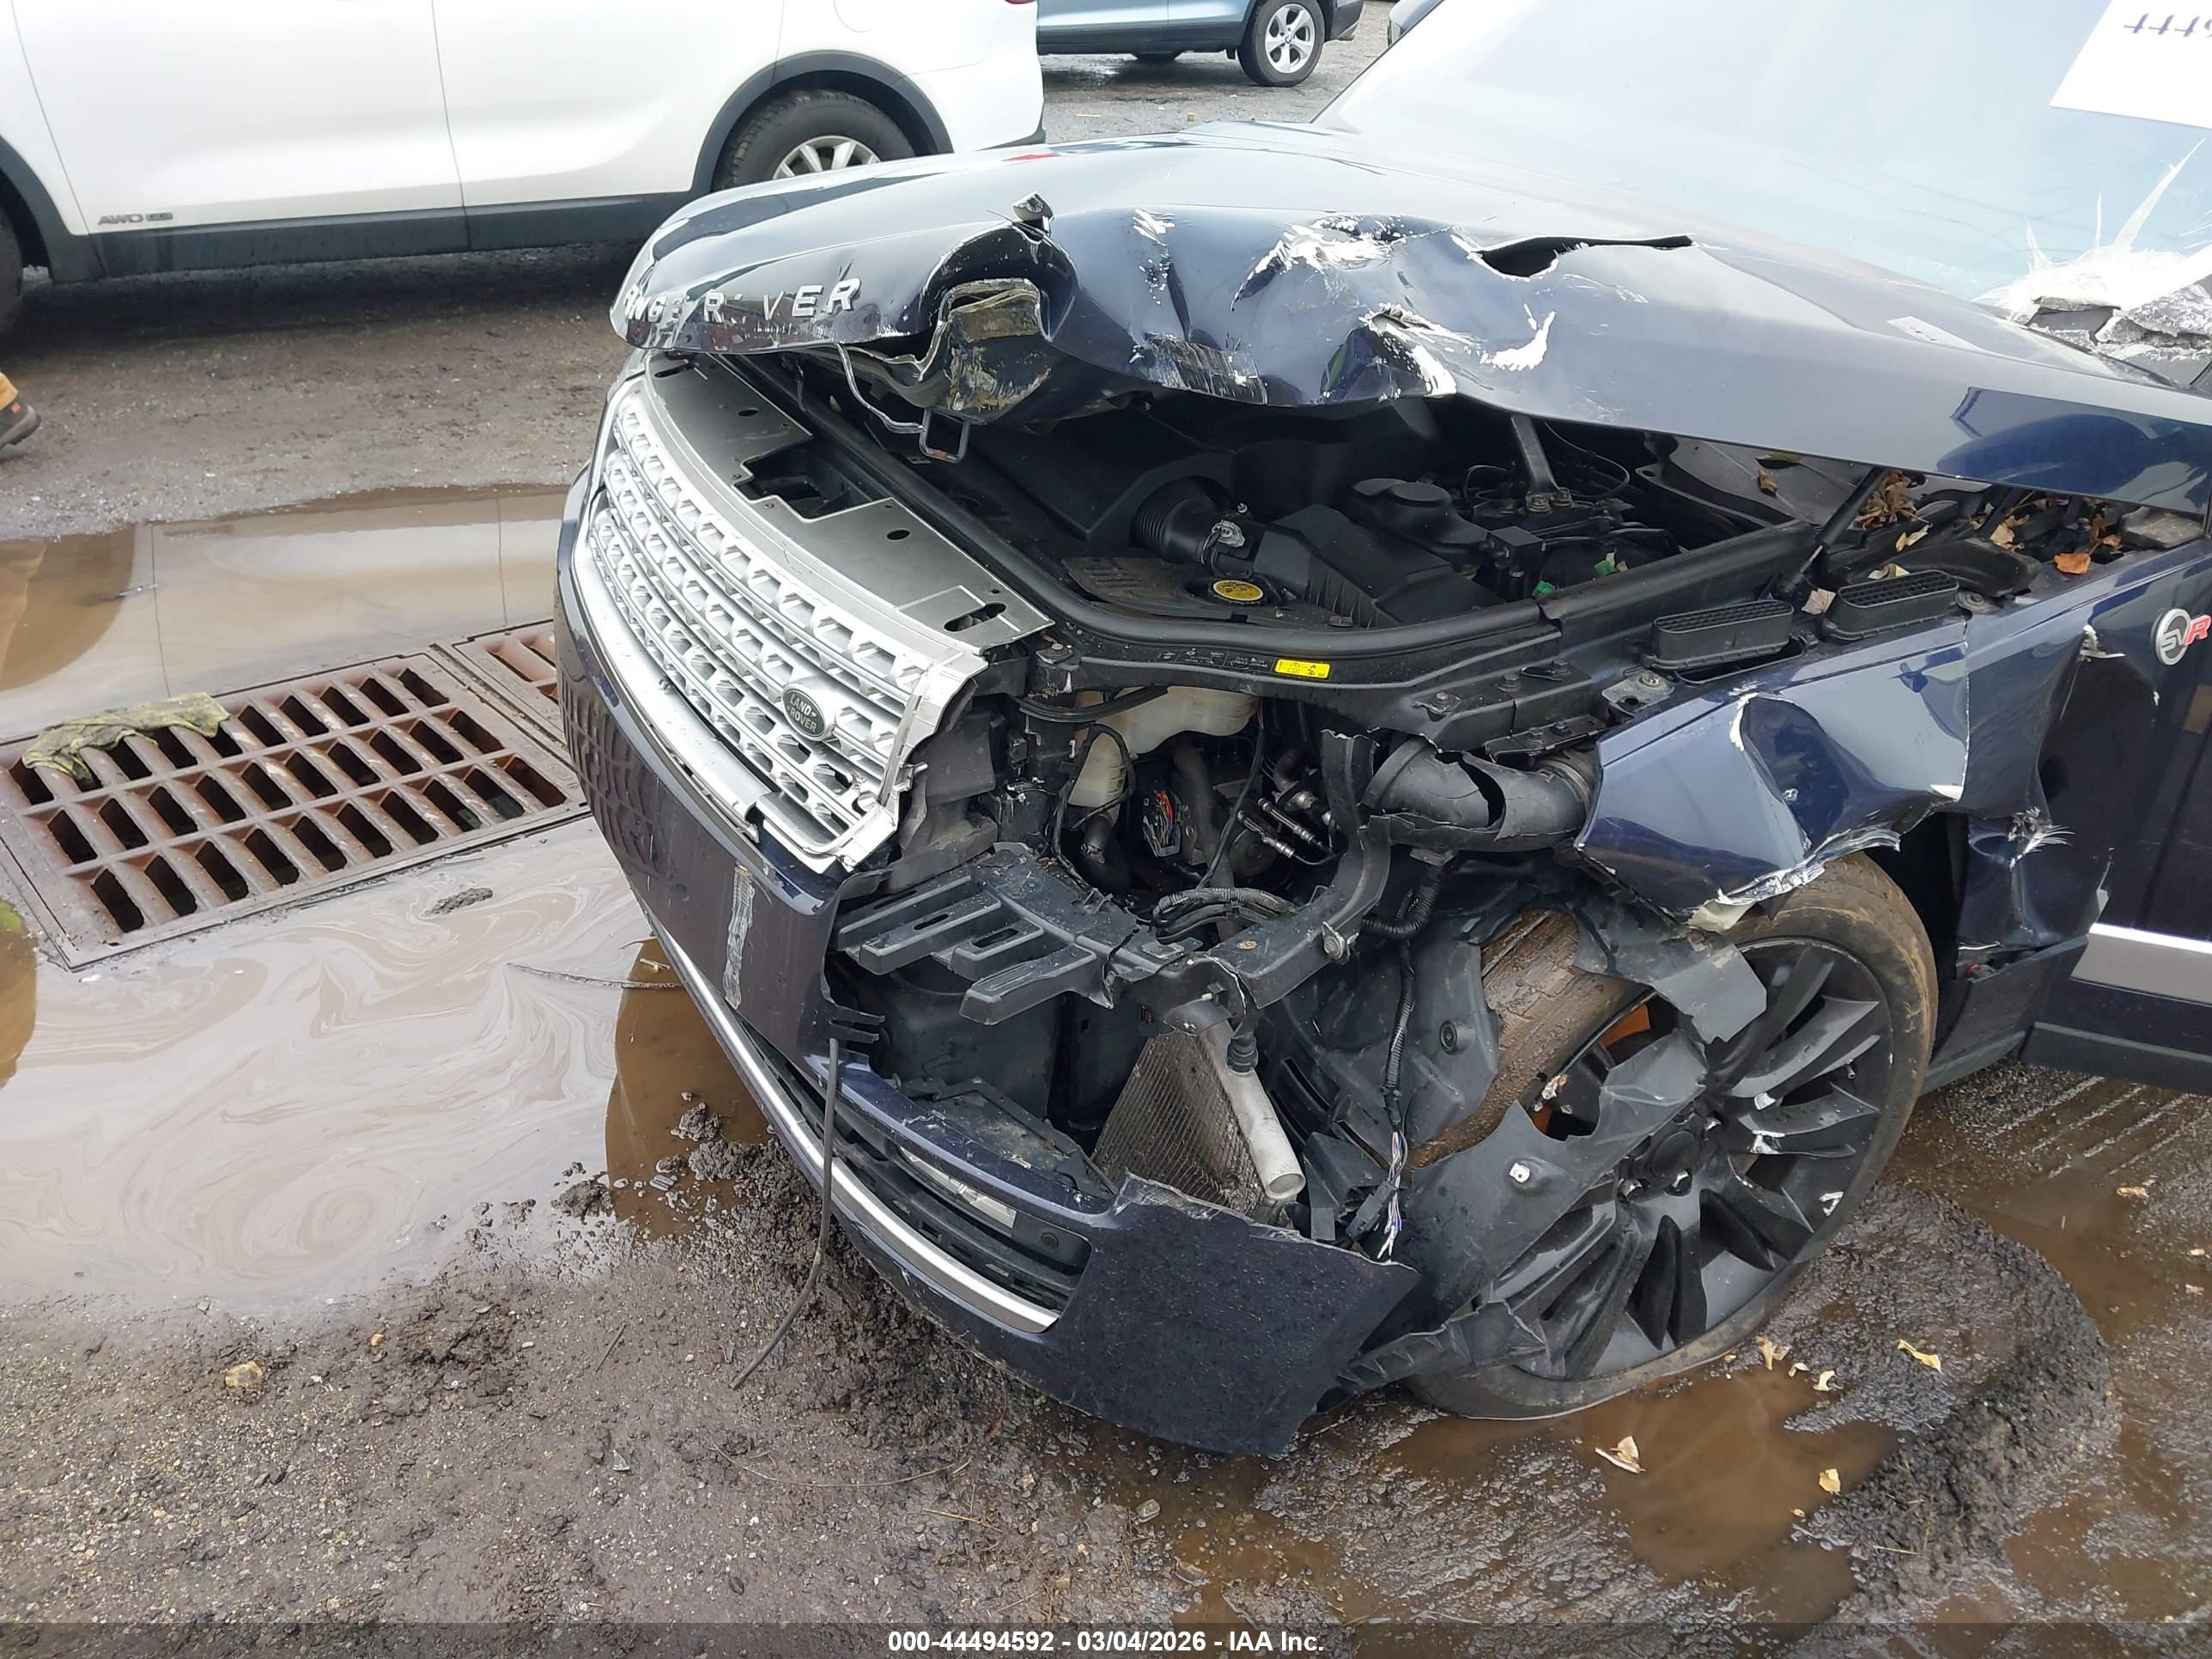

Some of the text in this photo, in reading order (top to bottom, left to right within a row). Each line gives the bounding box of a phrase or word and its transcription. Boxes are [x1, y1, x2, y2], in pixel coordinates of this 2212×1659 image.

[2156, 611, 2212, 658] SVR
[789, 693, 812, 716] LAND
[789, 708, 817, 734] ROVER
